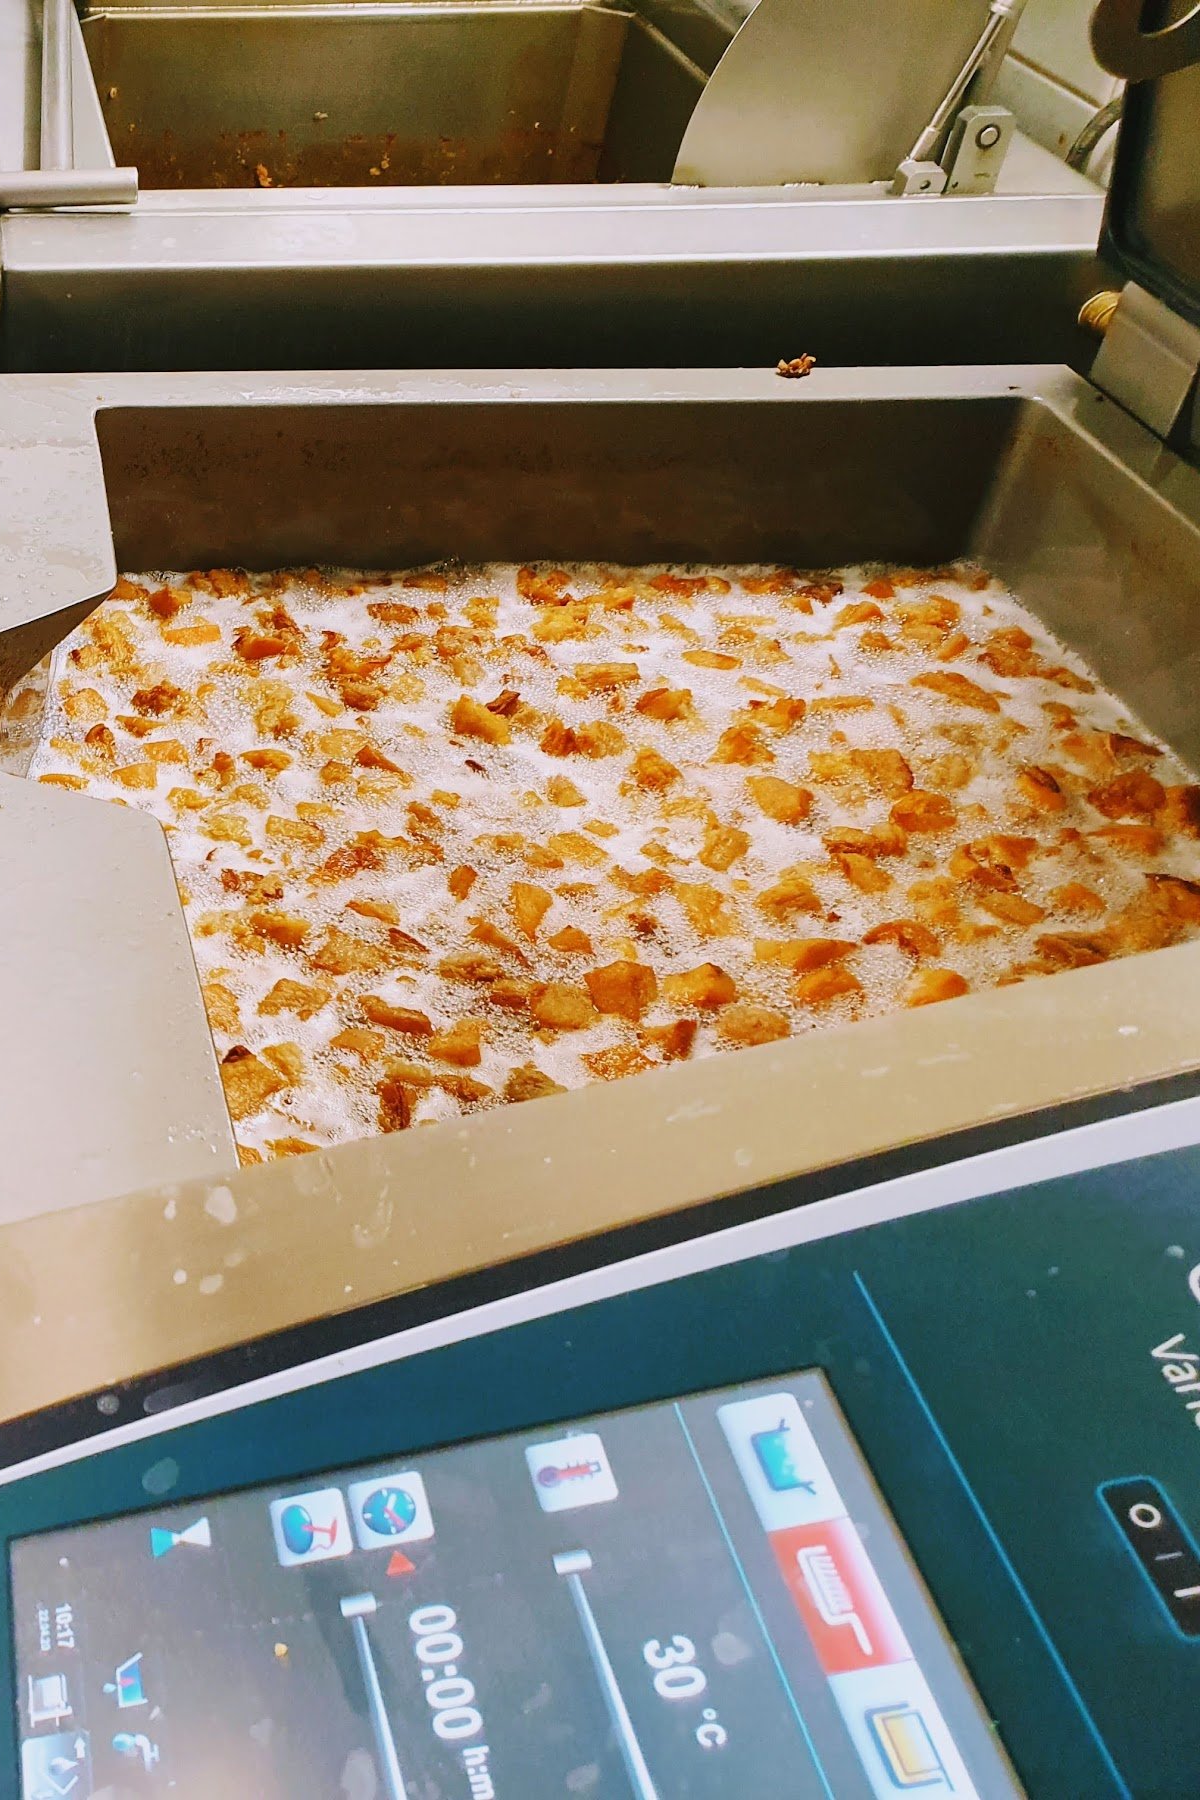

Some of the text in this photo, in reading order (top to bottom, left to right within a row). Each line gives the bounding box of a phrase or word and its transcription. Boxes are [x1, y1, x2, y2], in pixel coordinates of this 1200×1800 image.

[55, 1603, 75, 1649] 10:17
[408, 1604, 484, 1740] 00:00
[642, 1634, 727, 1749] 30 °C
